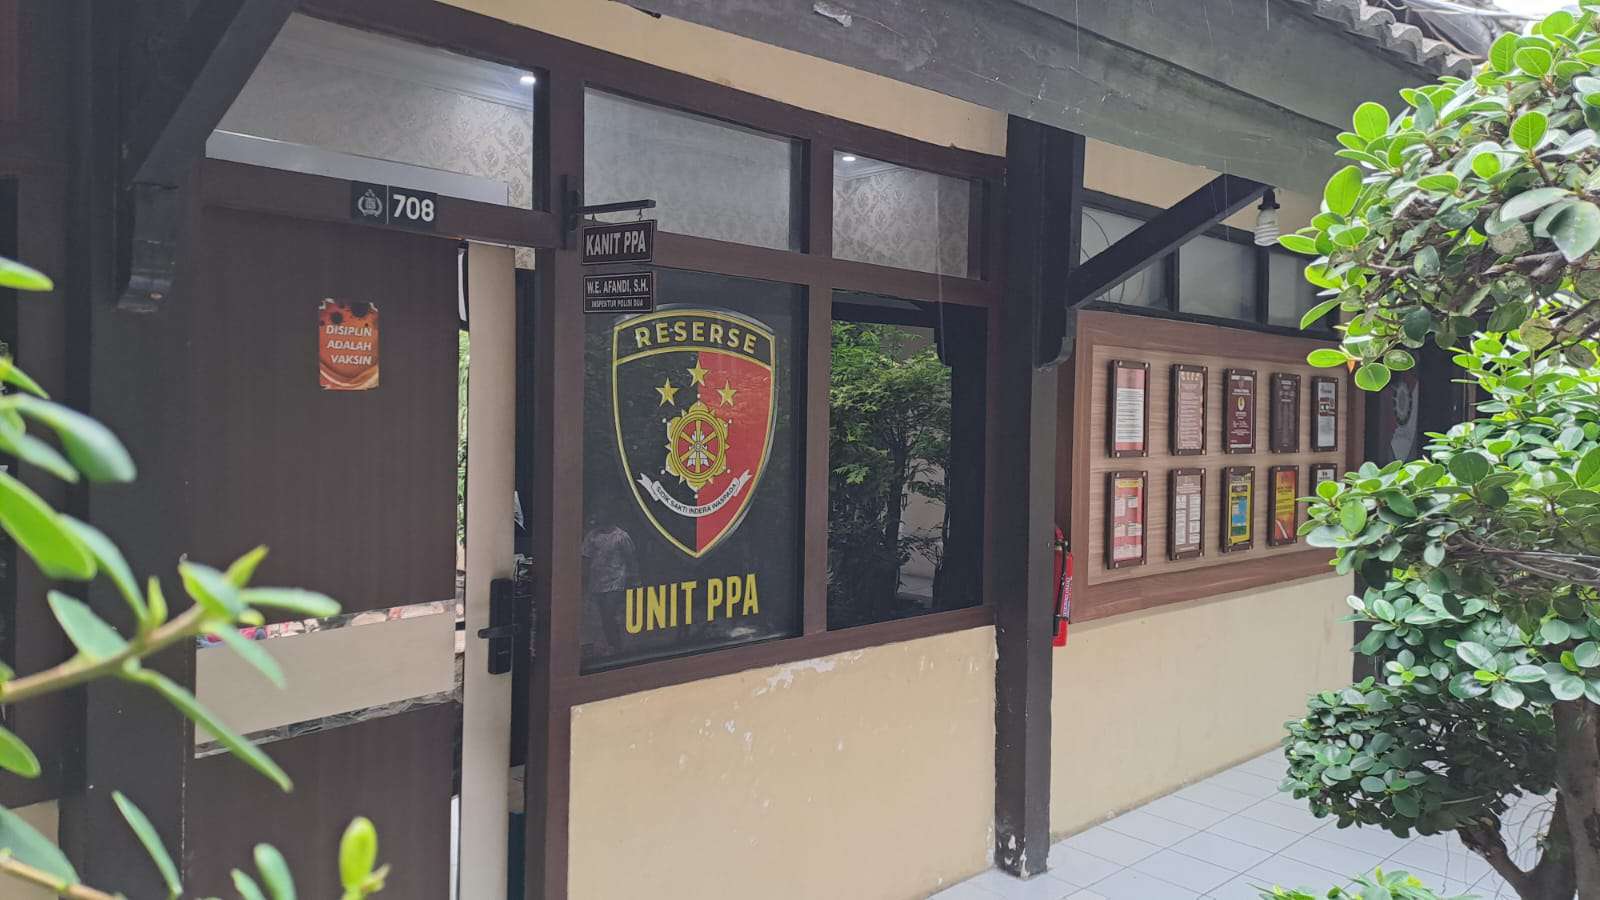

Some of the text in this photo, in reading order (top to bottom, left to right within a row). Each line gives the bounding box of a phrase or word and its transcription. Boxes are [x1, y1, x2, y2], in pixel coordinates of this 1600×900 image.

[392, 194, 434, 222] 708
[586, 230, 646, 256] KANIT PPA
[587, 279, 648, 295] W.E. AFANDI, S.H.
[326, 325, 372, 336] DISIPLIN
[635, 321, 758, 354] RESERSE
[327, 340, 372, 351] ADALAH
[331, 355, 372, 365] VAKSIN
[626, 573, 760, 634] UNIT PPA
